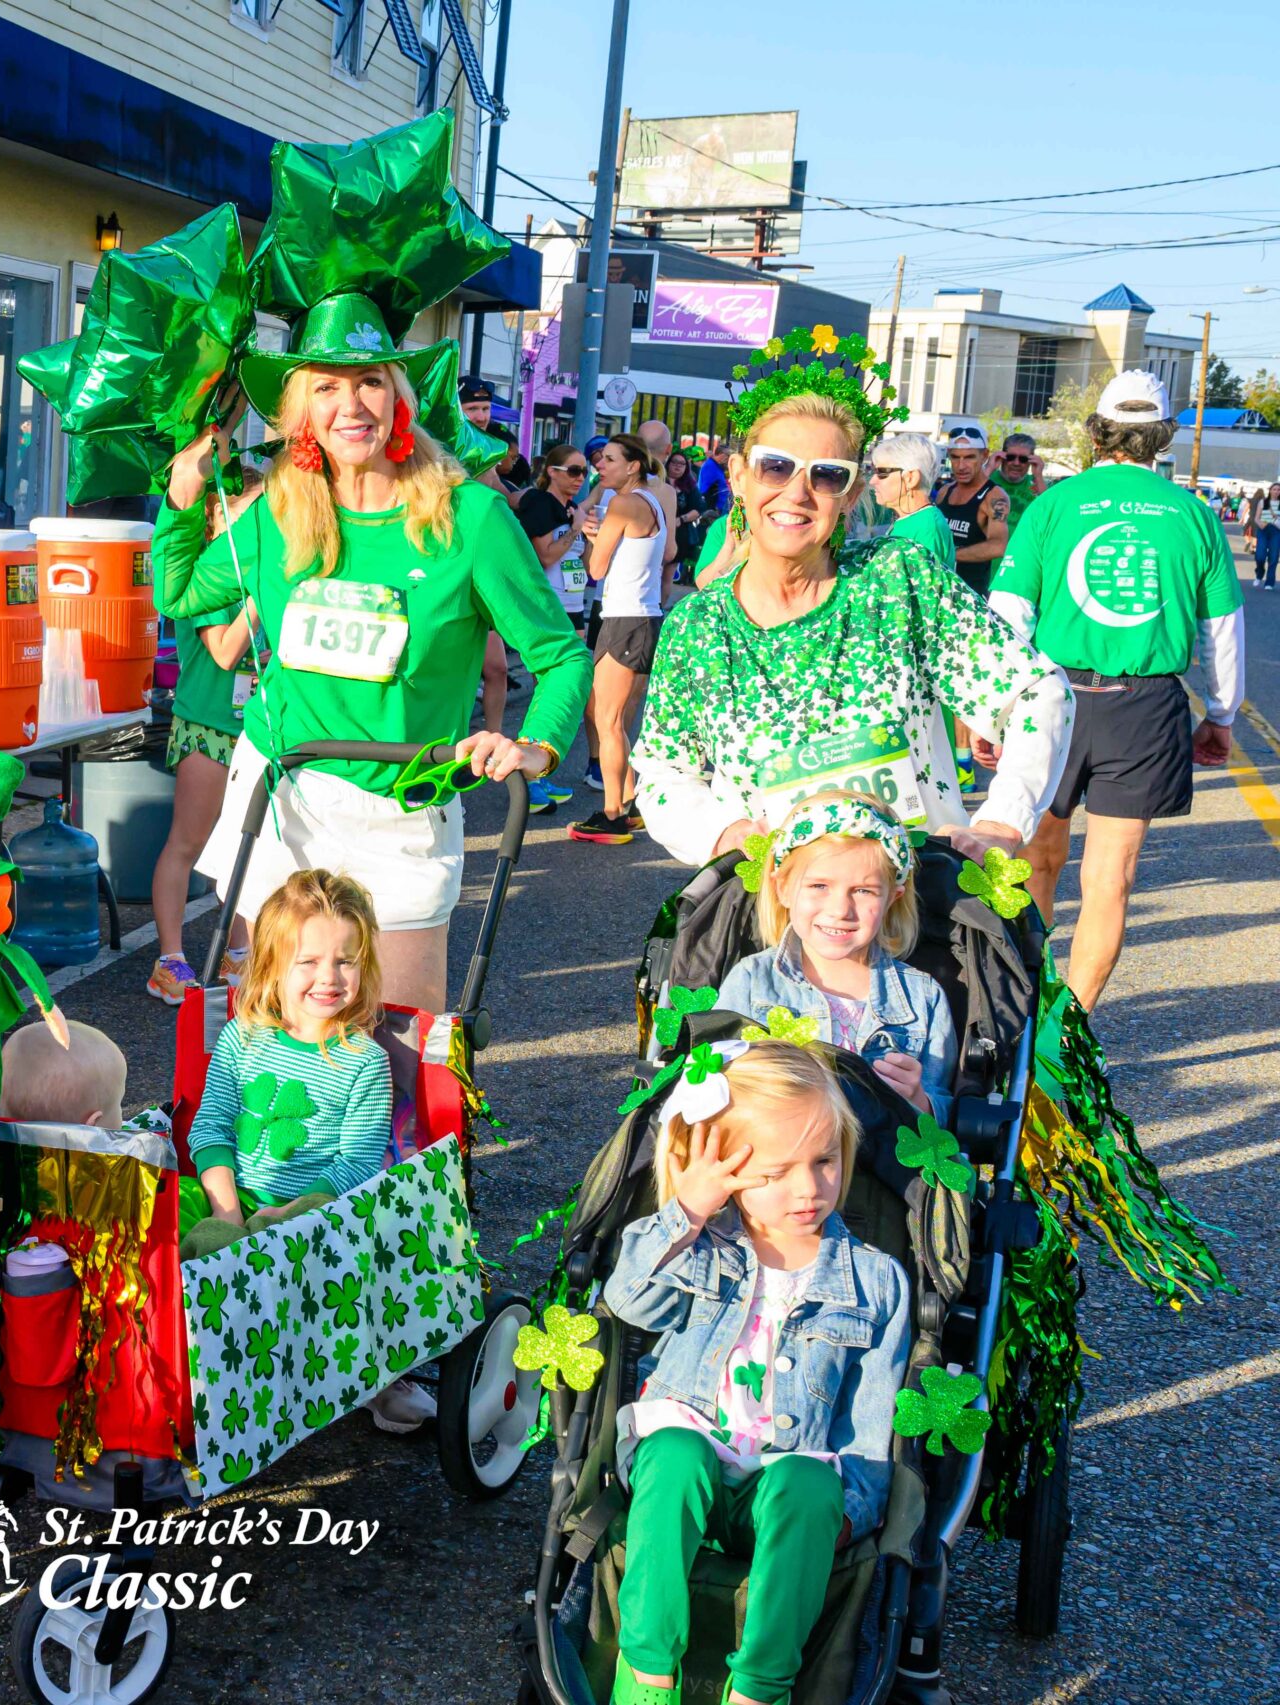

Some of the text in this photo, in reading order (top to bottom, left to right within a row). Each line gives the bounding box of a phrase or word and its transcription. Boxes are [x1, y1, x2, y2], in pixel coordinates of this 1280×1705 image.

[655, 291, 769, 328] Artsy Edge
[652, 328, 683, 338] POTTERY
[687, 330, 701, 339] ART
[705, 331, 734, 341] STUDIO
[949, 518, 970, 533] MILER
[302, 614, 387, 656] 1397
